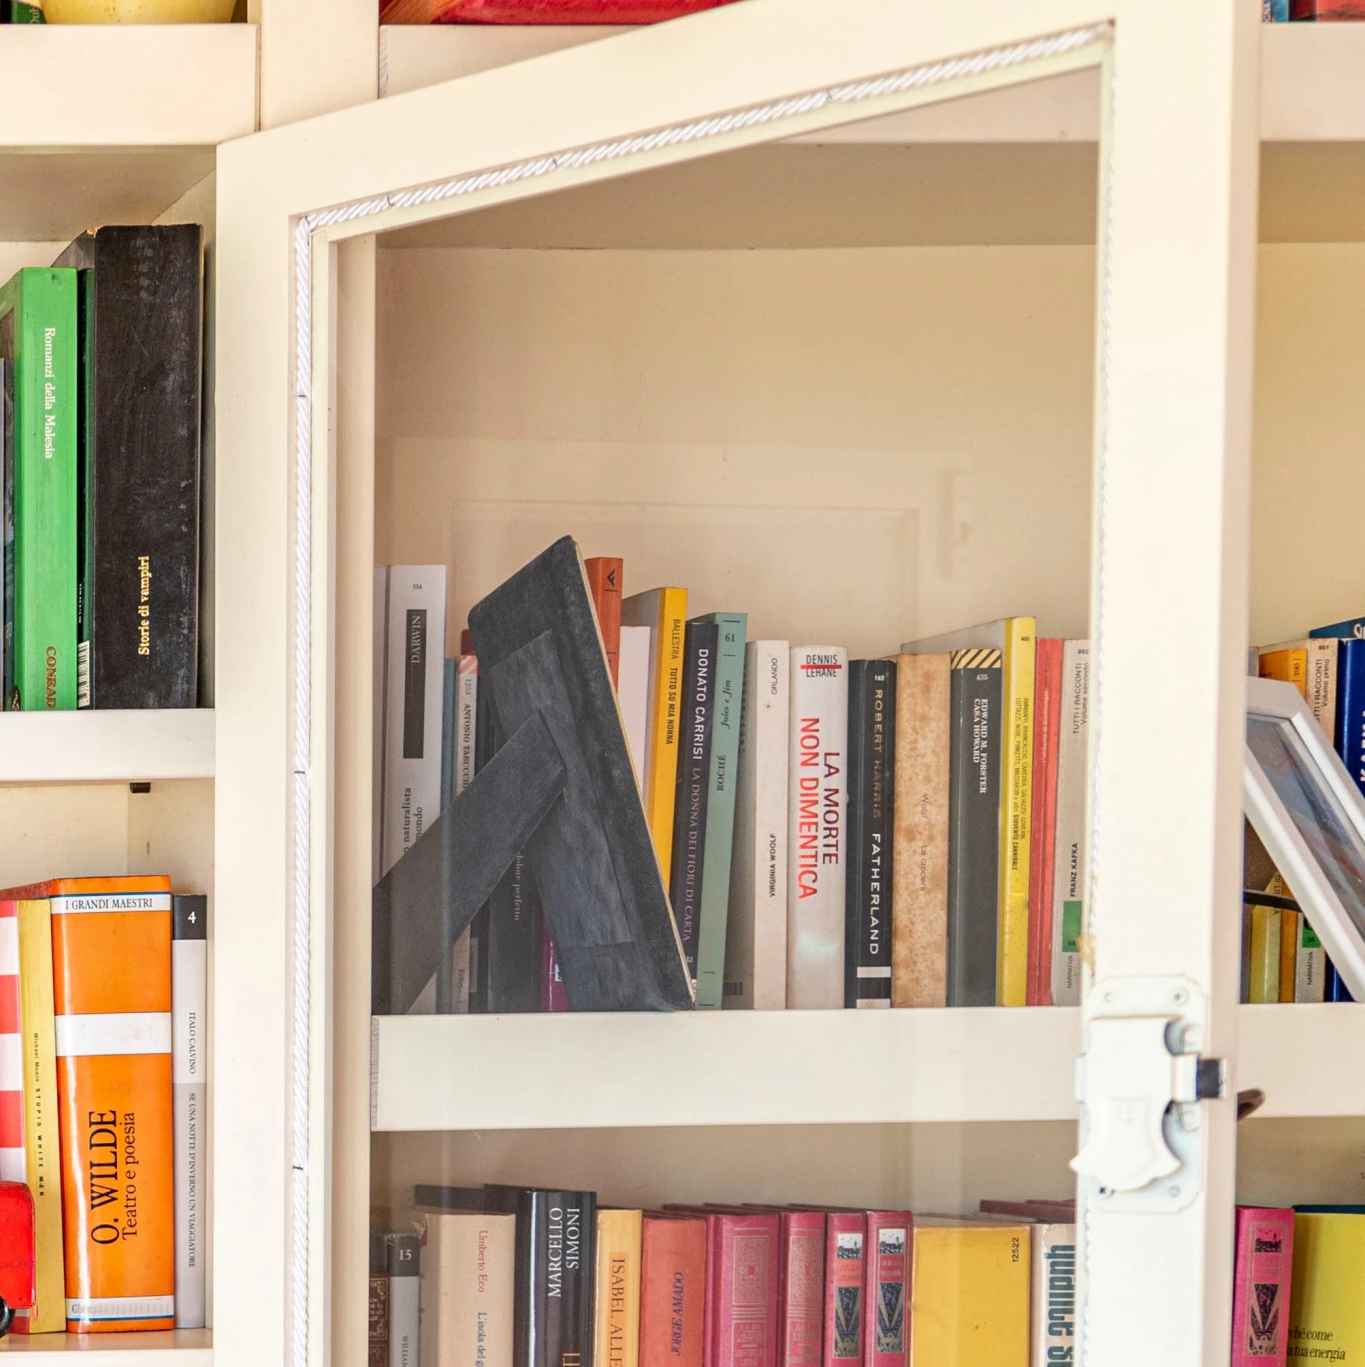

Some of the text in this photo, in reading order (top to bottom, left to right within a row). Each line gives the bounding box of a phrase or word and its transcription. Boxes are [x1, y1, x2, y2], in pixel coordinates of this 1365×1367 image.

[44, 327, 56, 460] Romanzi della Malesia
[138, 556, 150, 655] Storie di vampiri
[45, 647, 57, 708] CONRAD
[693, 648, 709, 760] DONATO CARRISI
[806, 654, 838, 666] DENNIS
[798, 717, 819, 900] NON DIMENTICA
[823, 752, 840, 866] LA MORTE
[72, 899, 110, 911] GRANDI
[112, 897, 153, 909] MAESTRI
[188, 912, 196, 923] 4
[869, 833, 881, 955] FATHERLAND
[90, 1110, 119, 1245] O. WILDE
[121, 1112, 138, 1240] Teatro e poesia
[548, 1207, 563, 1299] MARCELLO
[566, 1207, 581, 1270] SIMONI
[1011, 1236, 1021, 1263] 12522
[611, 1258, 626, 1322] ISABEL
